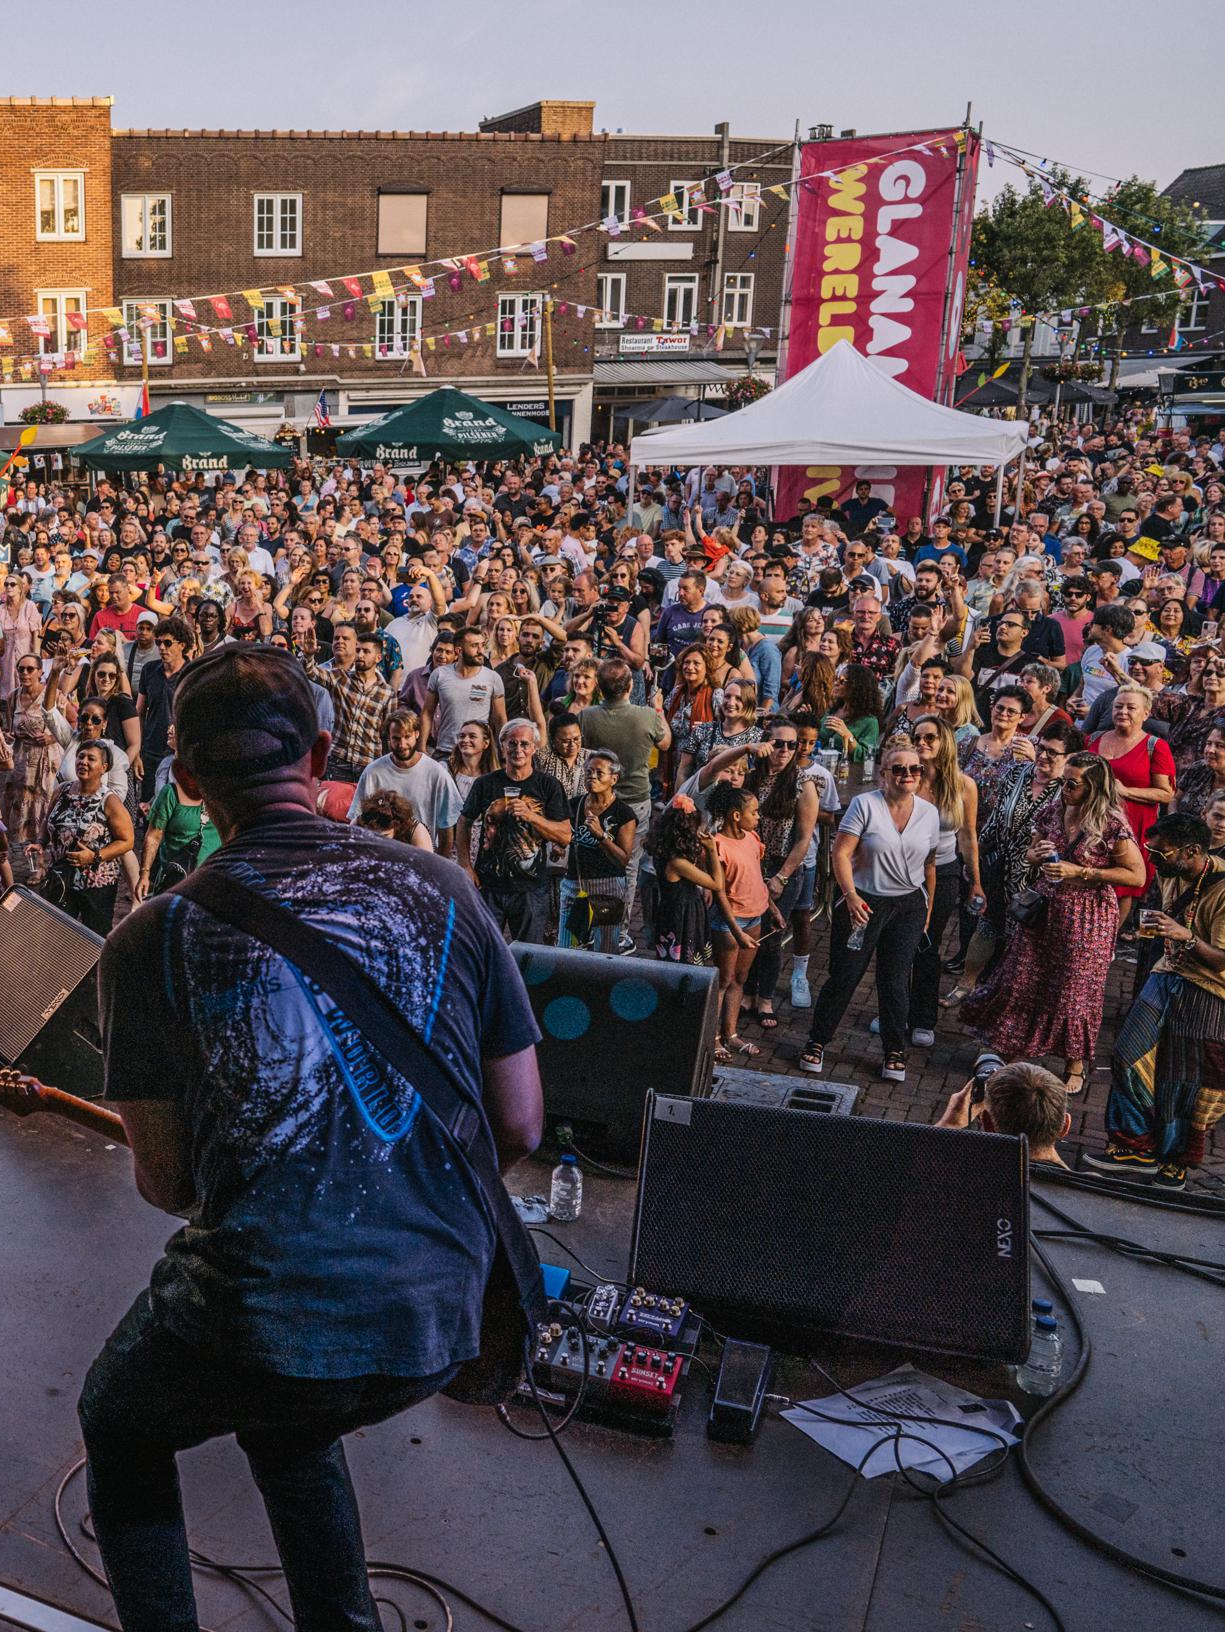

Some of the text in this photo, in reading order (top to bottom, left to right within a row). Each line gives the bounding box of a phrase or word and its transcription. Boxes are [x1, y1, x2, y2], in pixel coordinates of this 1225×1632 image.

[507, 402, 545, 411] LENDERS
[376, 444, 418, 460] Brand
[182, 454, 228, 470] Brand
[44, 992, 65, 1014] NEXO
[996, 1217, 1014, 1258] NEXO
[631, 1368, 659, 1380] SUNSET
